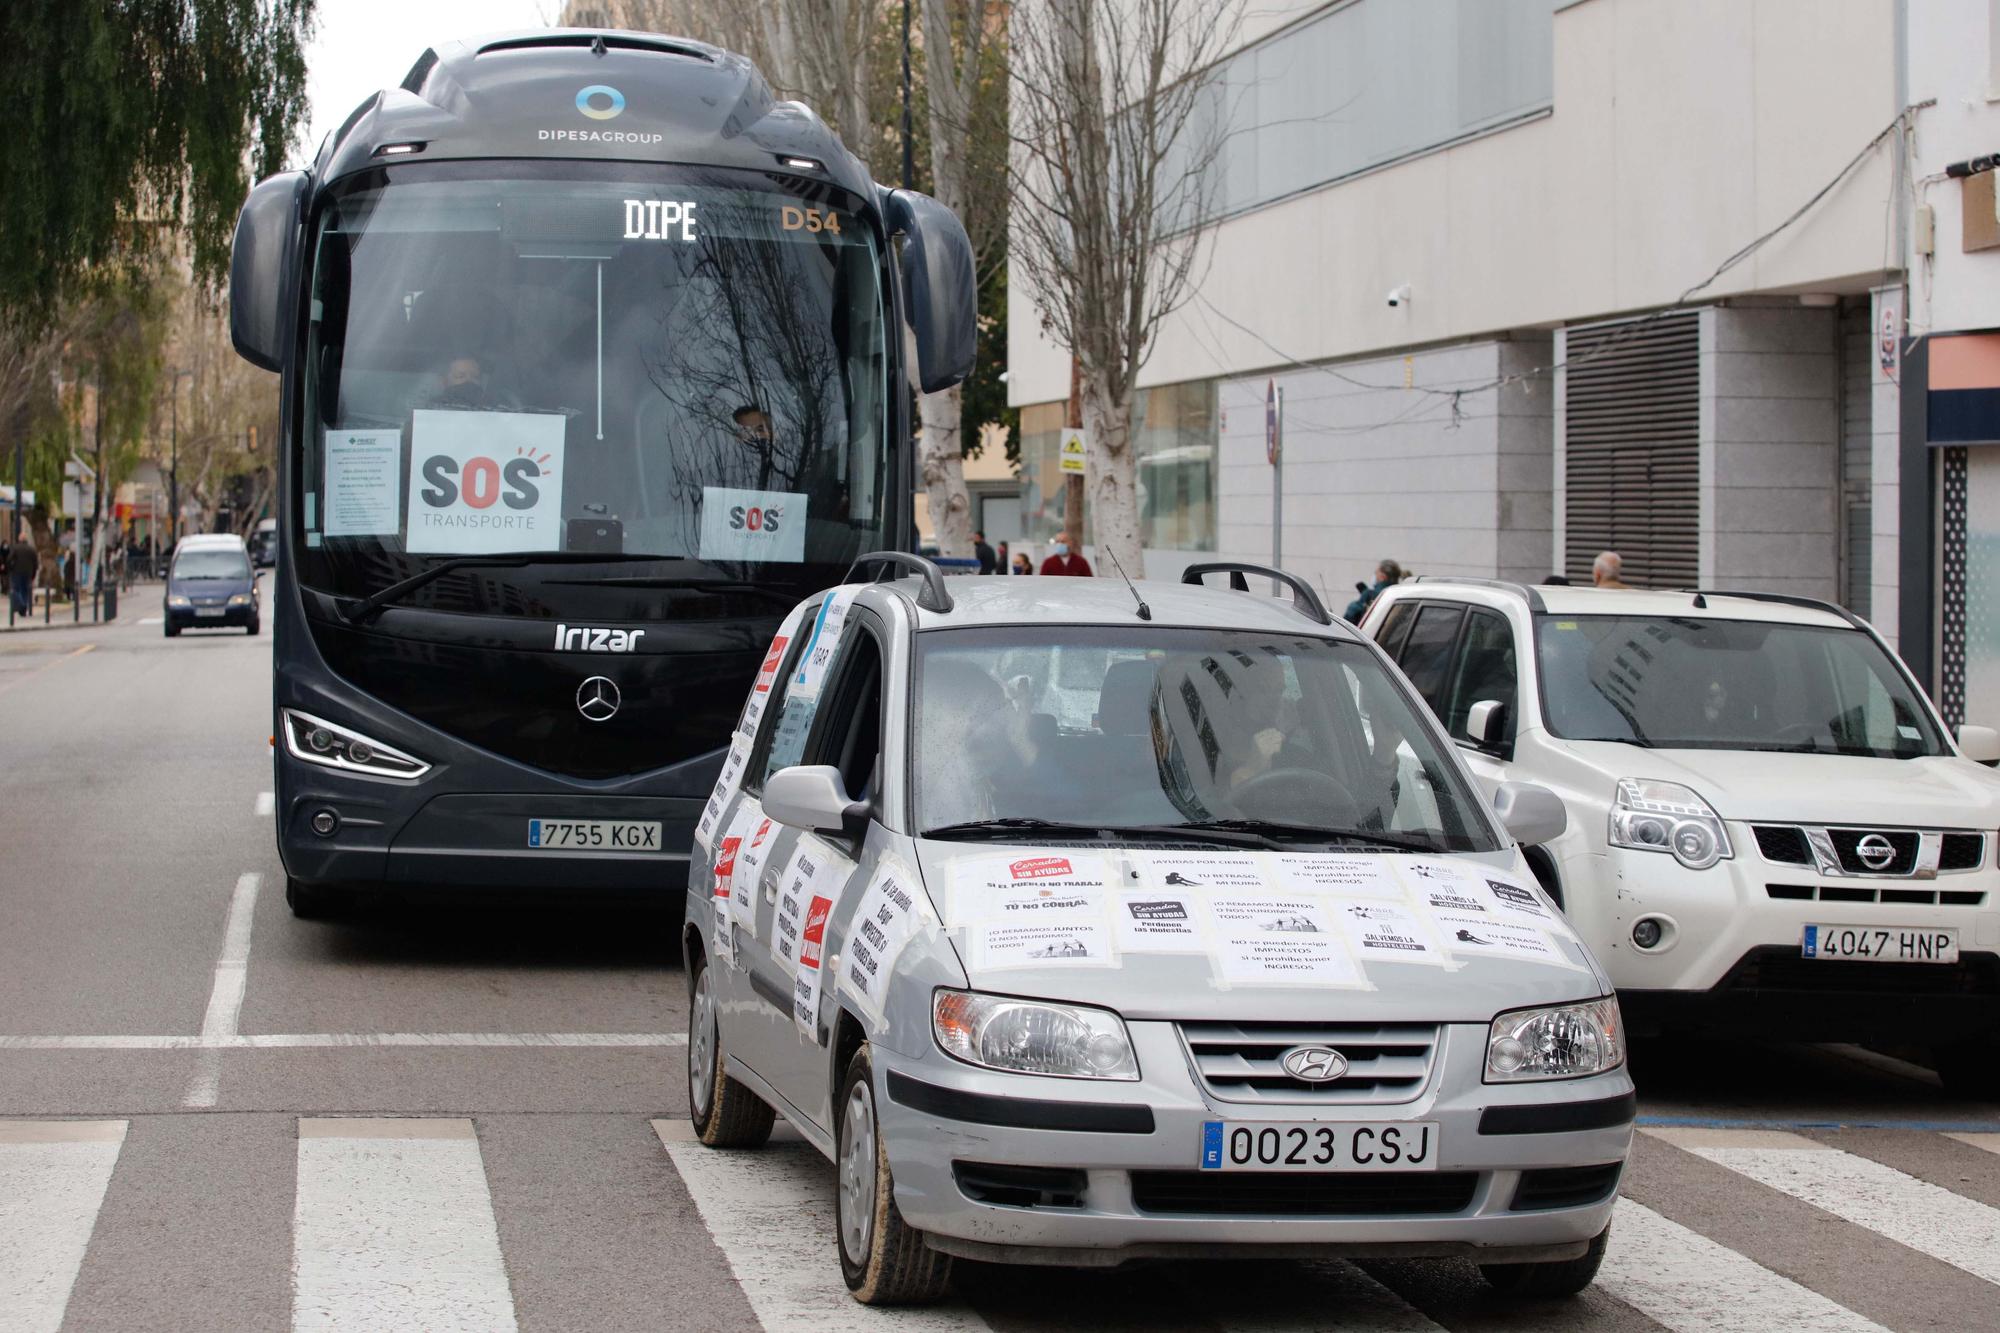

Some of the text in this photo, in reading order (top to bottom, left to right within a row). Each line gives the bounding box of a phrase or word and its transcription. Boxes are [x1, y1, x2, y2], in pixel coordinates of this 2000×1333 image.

[538, 129, 663, 144] DIPESAGROUP
[623, 199, 697, 241] DIPE
[781, 206, 841, 235] D54
[421, 454, 541, 511] SOS
[423, 513, 536, 530] TRANSPORTE
[729, 505, 779, 532] SOS
[554, 624, 646, 652] Irizar
[545, 823, 655, 847] 7755 KGX
[1034, 867, 1071, 877] AYUDAS
[1133, 903, 1178, 912] Cerrados
[1430, 893, 1467, 901] SALVEMOS
[1364, 933, 1403, 942] SALVEMOS
[1824, 930, 1951, 960] 4047 HNP
[1208, 1151, 1217, 1162] E
[1230, 1126, 1429, 1165] 0023 CSJ
